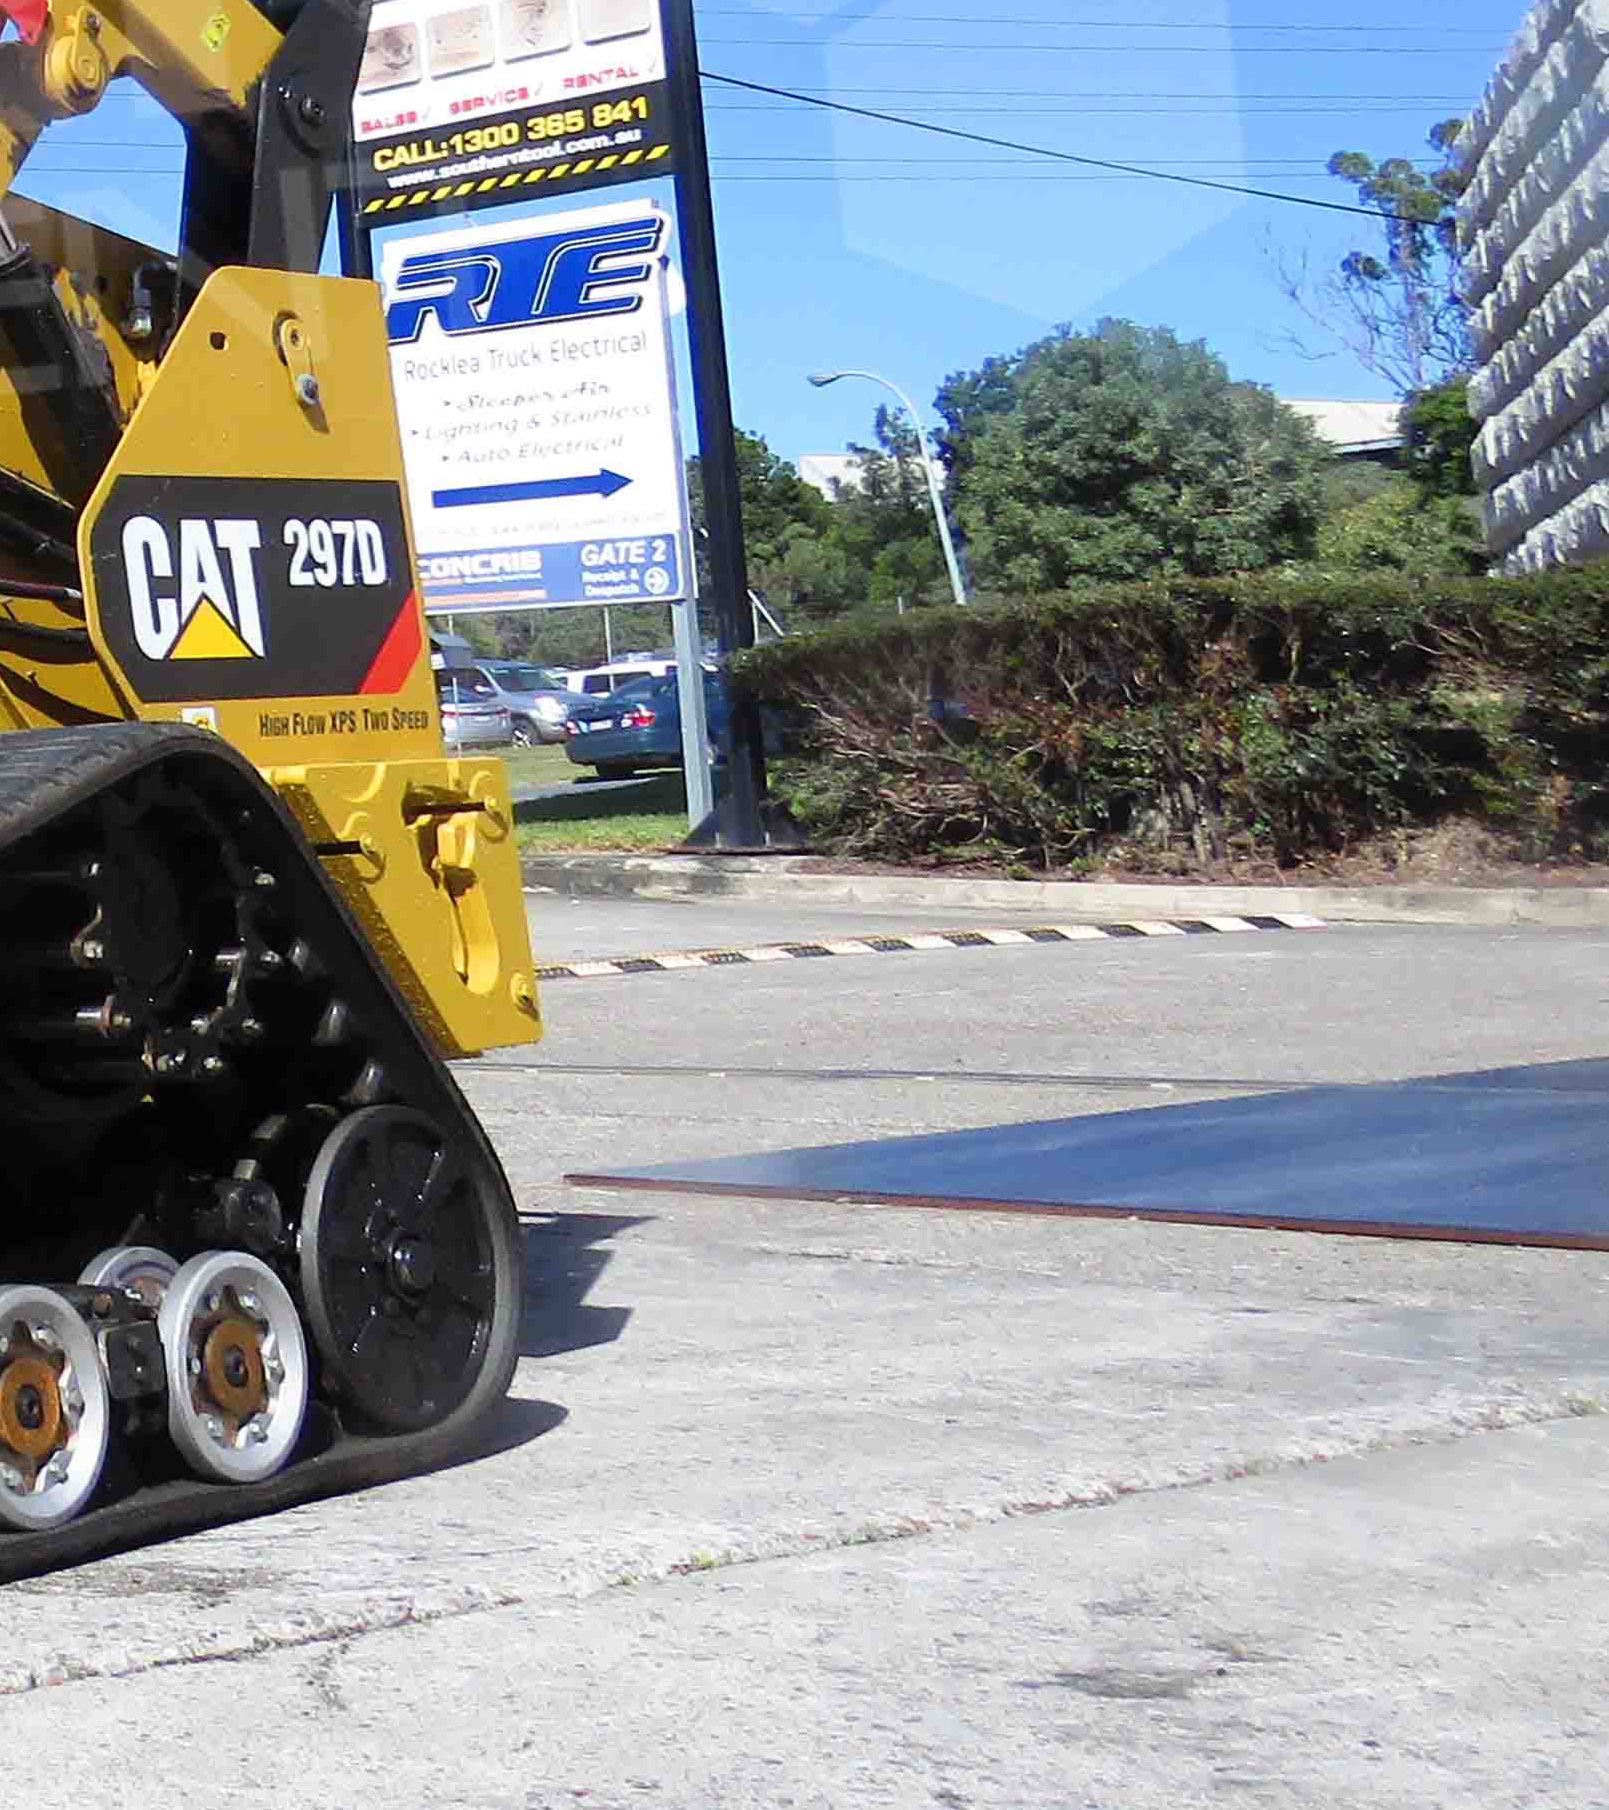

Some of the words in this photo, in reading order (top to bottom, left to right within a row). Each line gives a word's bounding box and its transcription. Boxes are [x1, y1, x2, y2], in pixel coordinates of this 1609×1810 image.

[449, 86, 531, 116] SERVICE
[562, 64, 640, 90] RENTAL
[527, 110, 587, 142] 365
[592, 96, 650, 129] 841
[387, 128, 643, 190] www.southerntool.com.au
[386, 216, 663, 346] RTE
[403, 352, 482, 383] Rocklea
[487, 344, 543, 374] Truck
[548, 330, 649, 368] Electrical
[581, 541, 646, 567] GATE
[651, 538, 667, 563] 2
[122, 516, 265, 662] CAT
[284, 519, 388, 588] 297D
[329, 709, 357, 734] XPS
